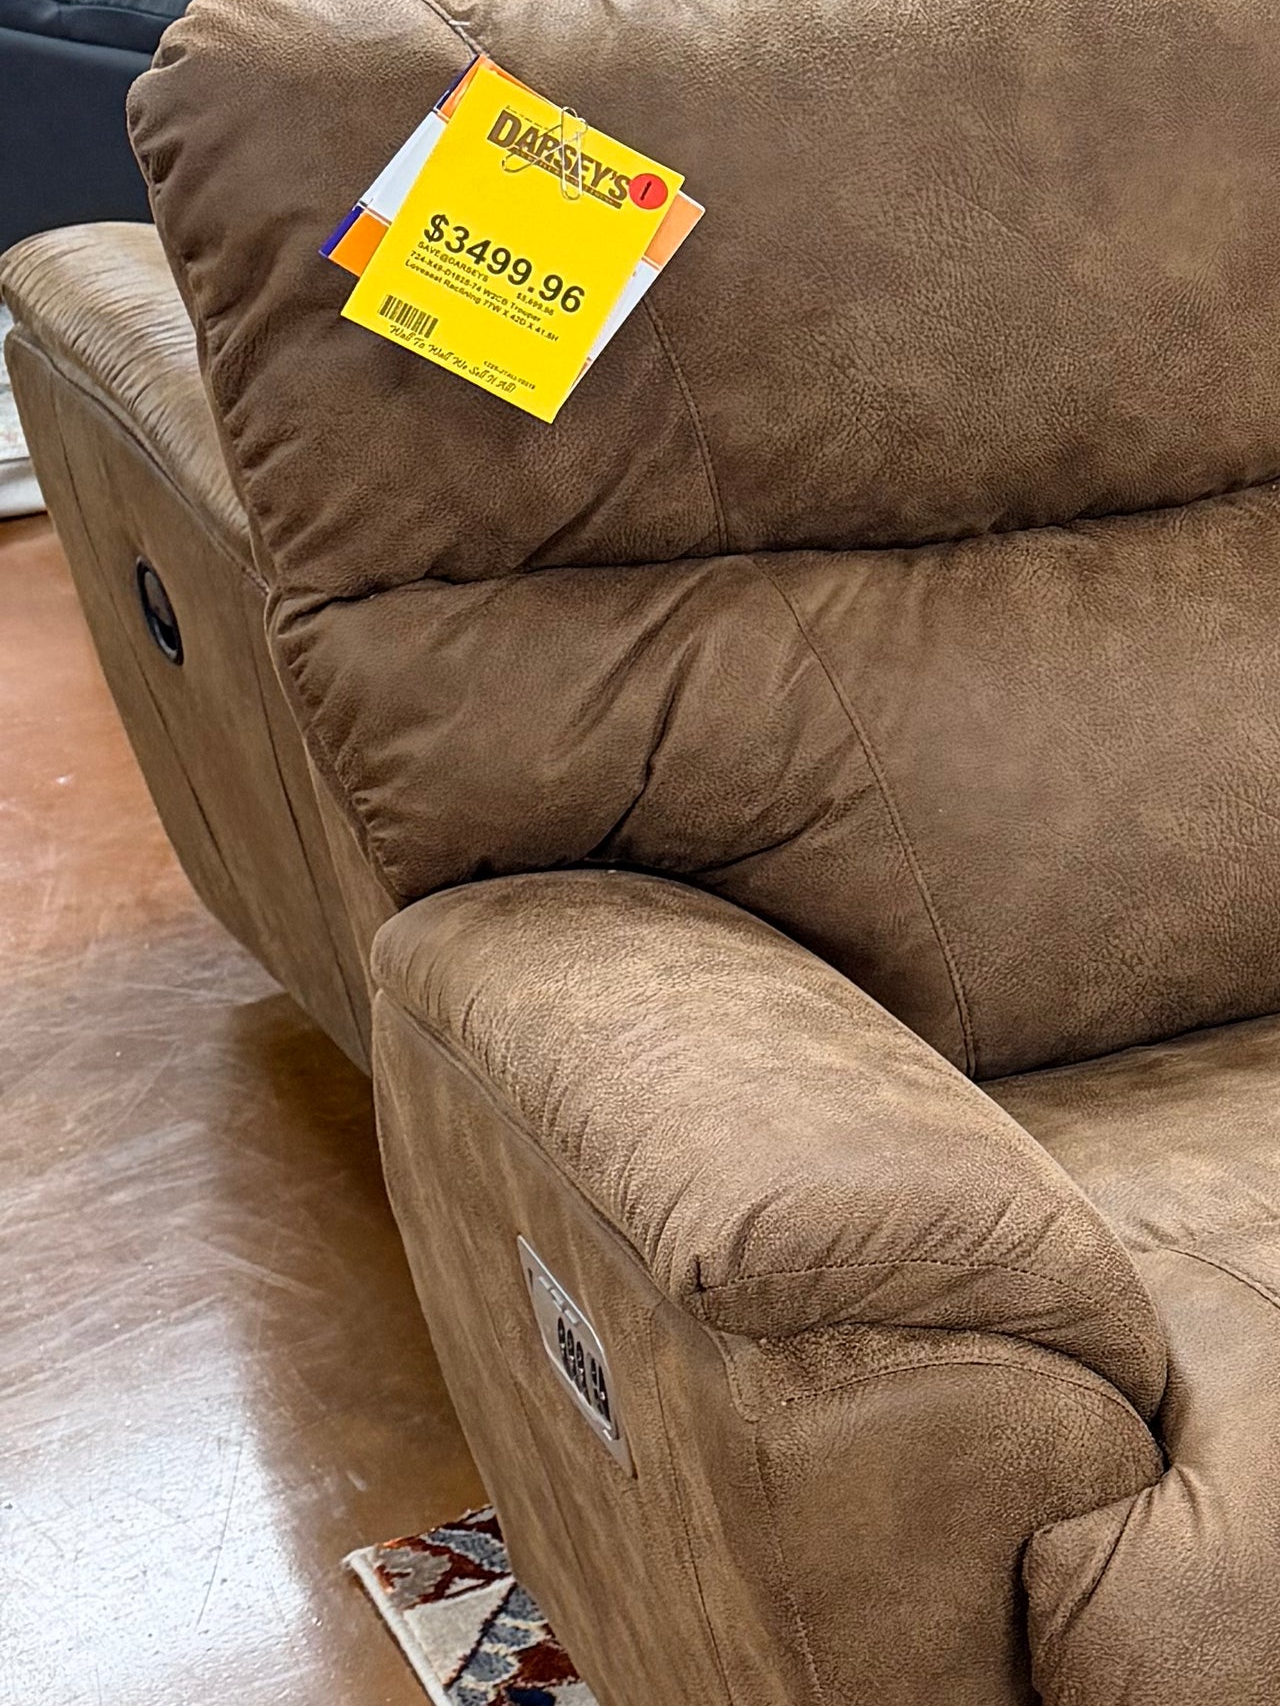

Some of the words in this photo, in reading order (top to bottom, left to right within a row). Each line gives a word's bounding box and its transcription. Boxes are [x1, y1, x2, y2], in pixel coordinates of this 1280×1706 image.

[487, 109, 630, 200] DARSEY'S
[404, 259, 443, 284] Loveseat
[422, 214, 586, 314] $3499.96
